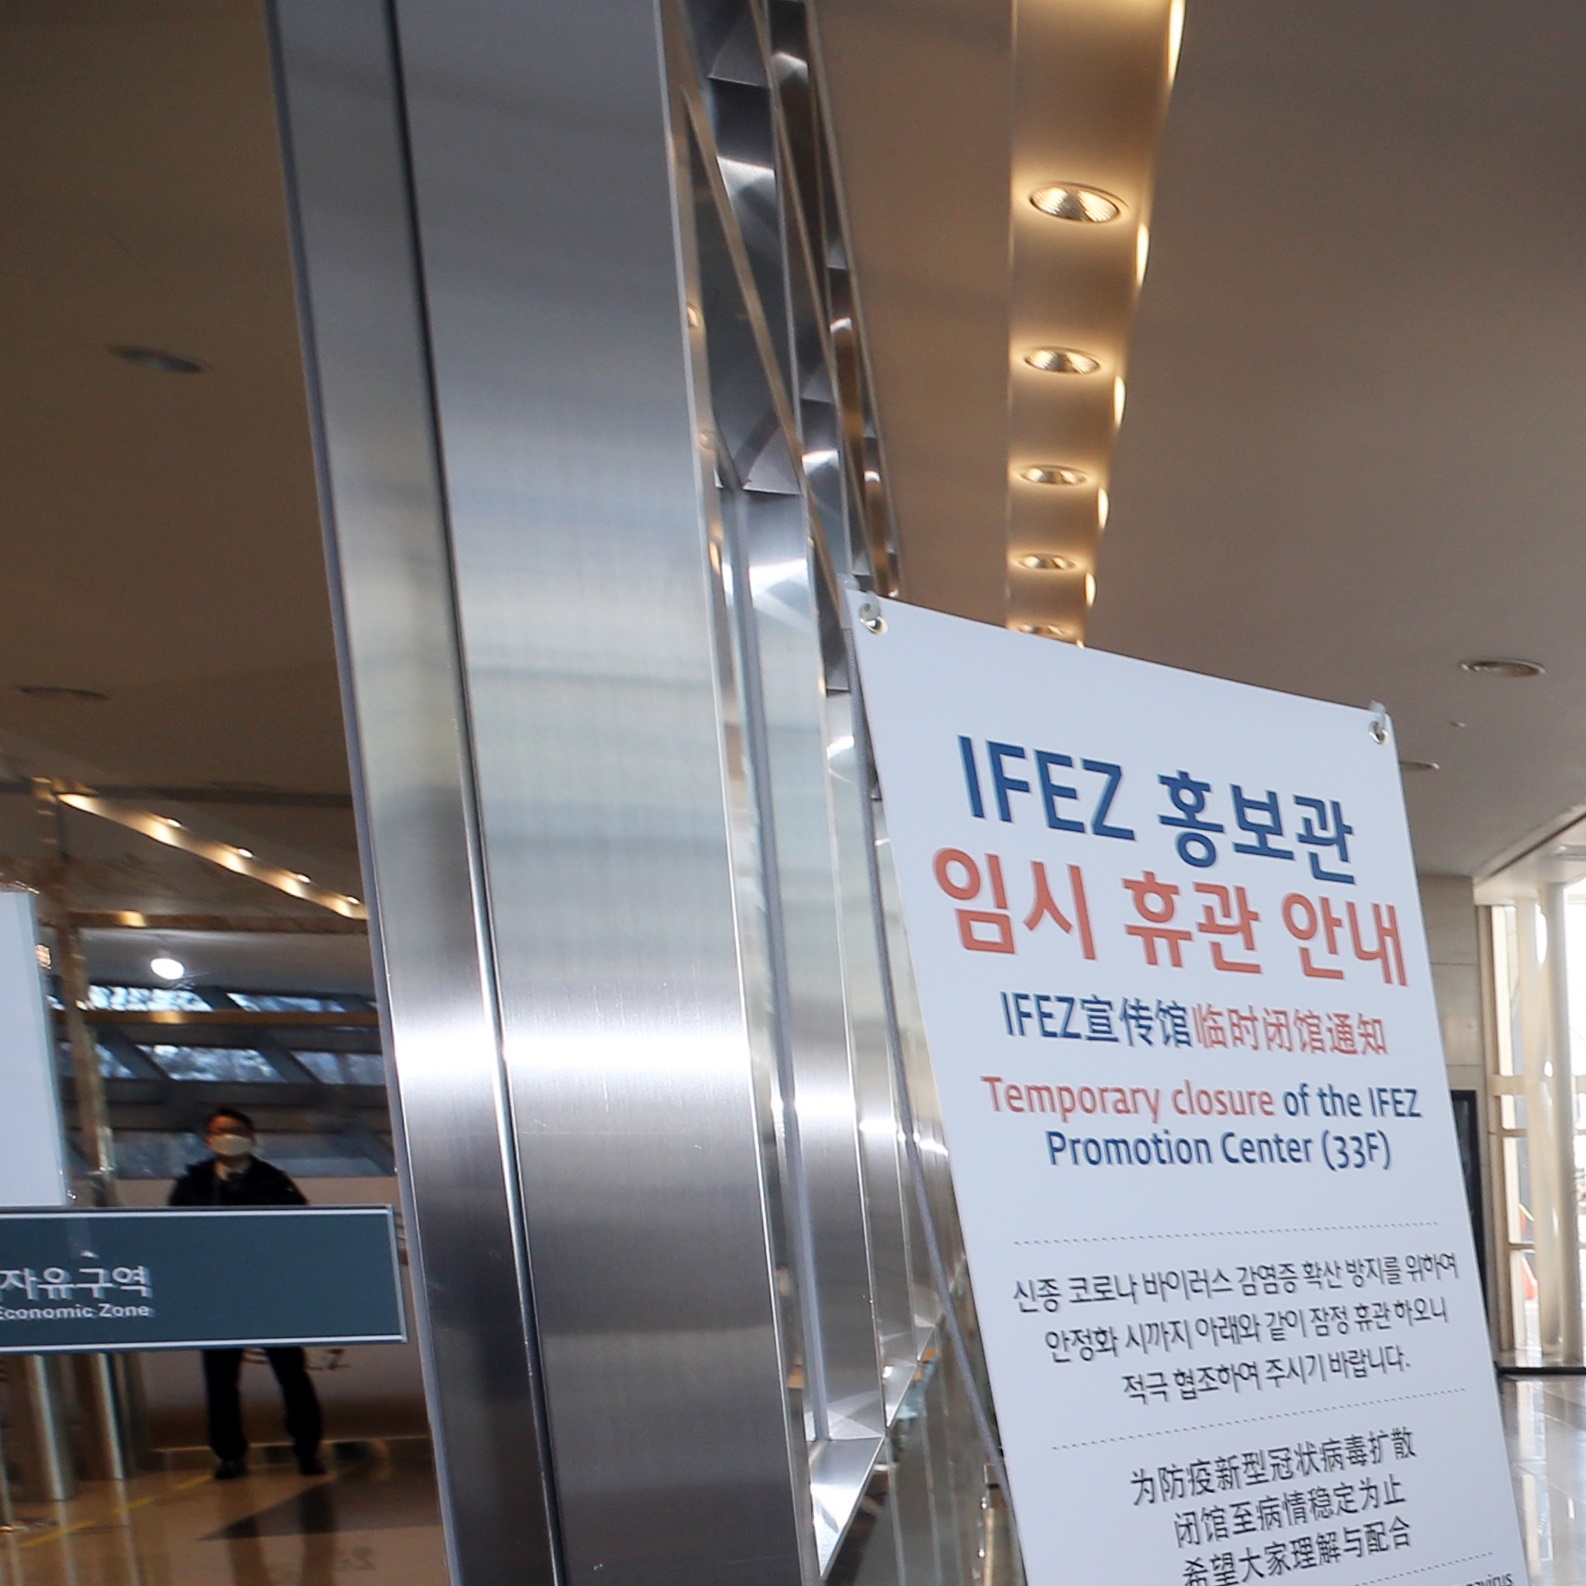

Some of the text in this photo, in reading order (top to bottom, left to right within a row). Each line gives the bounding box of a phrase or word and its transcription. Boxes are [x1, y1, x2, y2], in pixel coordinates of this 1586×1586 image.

[957, 735, 1356, 886] IFEZ 홍보관
[932, 848, 1409, 986] 임시 휴관 안내
[980, 1075, 1421, 1123] Temporary closure of the IFEZ
[1046, 1131, 1391, 1171] Promotion Center (33F)
[98, 1303, 153, 1318] Zone
[1013, 1252, 1459, 1314] 신종 코로나 바이러스 감염증 확산 방지를 위하여
[1045, 1296, 1449, 1364] 안정화 시까지 아래와 같이 잠정 휴관 하오니
[1121, 1344, 1410, 1405] 적극 협조하여 주시기 바랍니다.
